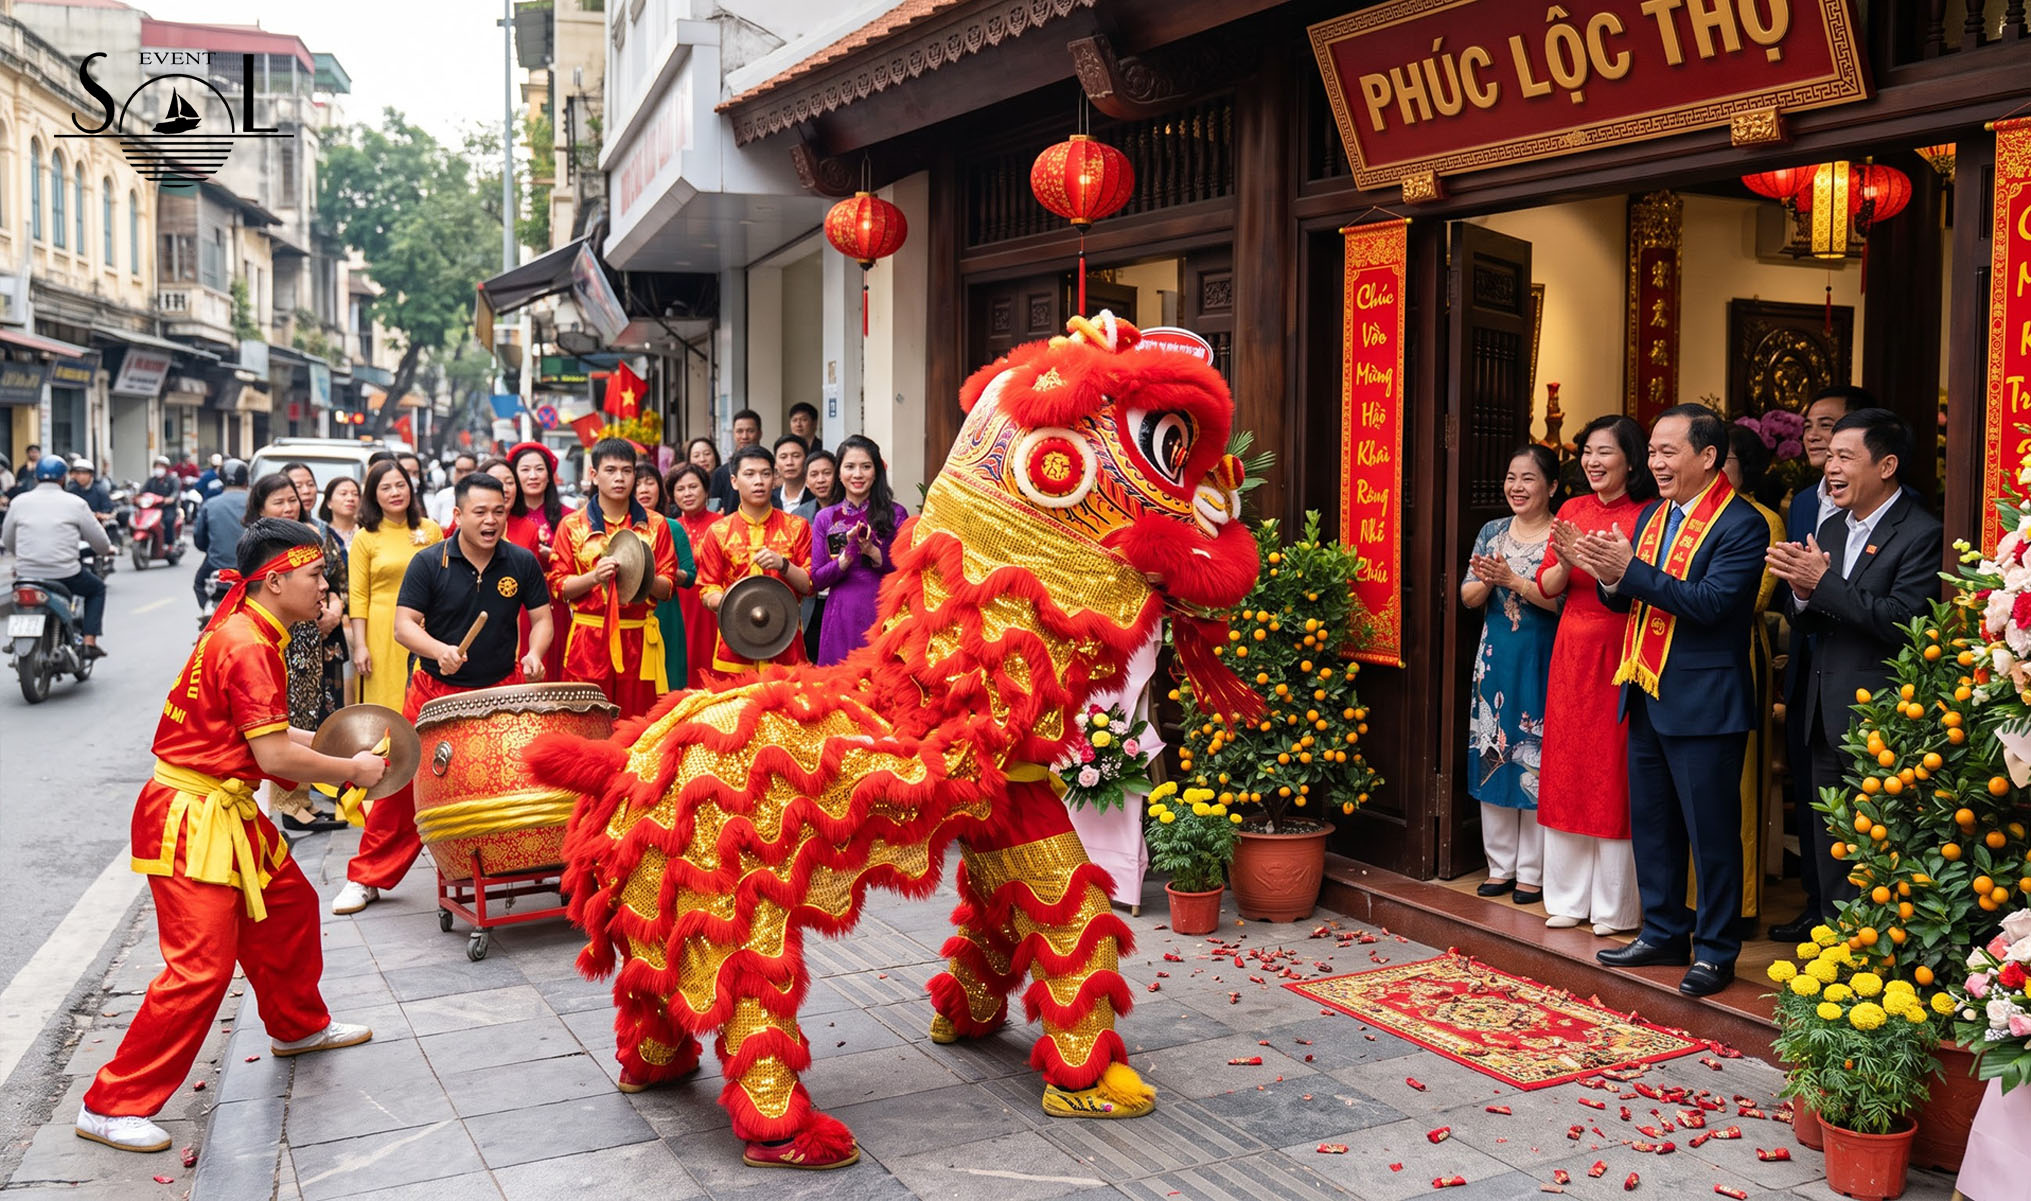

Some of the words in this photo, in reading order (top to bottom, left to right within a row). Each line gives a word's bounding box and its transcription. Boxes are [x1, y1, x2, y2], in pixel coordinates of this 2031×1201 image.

[1359, 38, 1499, 132] PHÚC
[1508, 6, 1632, 103] LỘC
[1641, 0, 1789, 66] THỌ
[1357, 282, 1394, 309] Chúc
